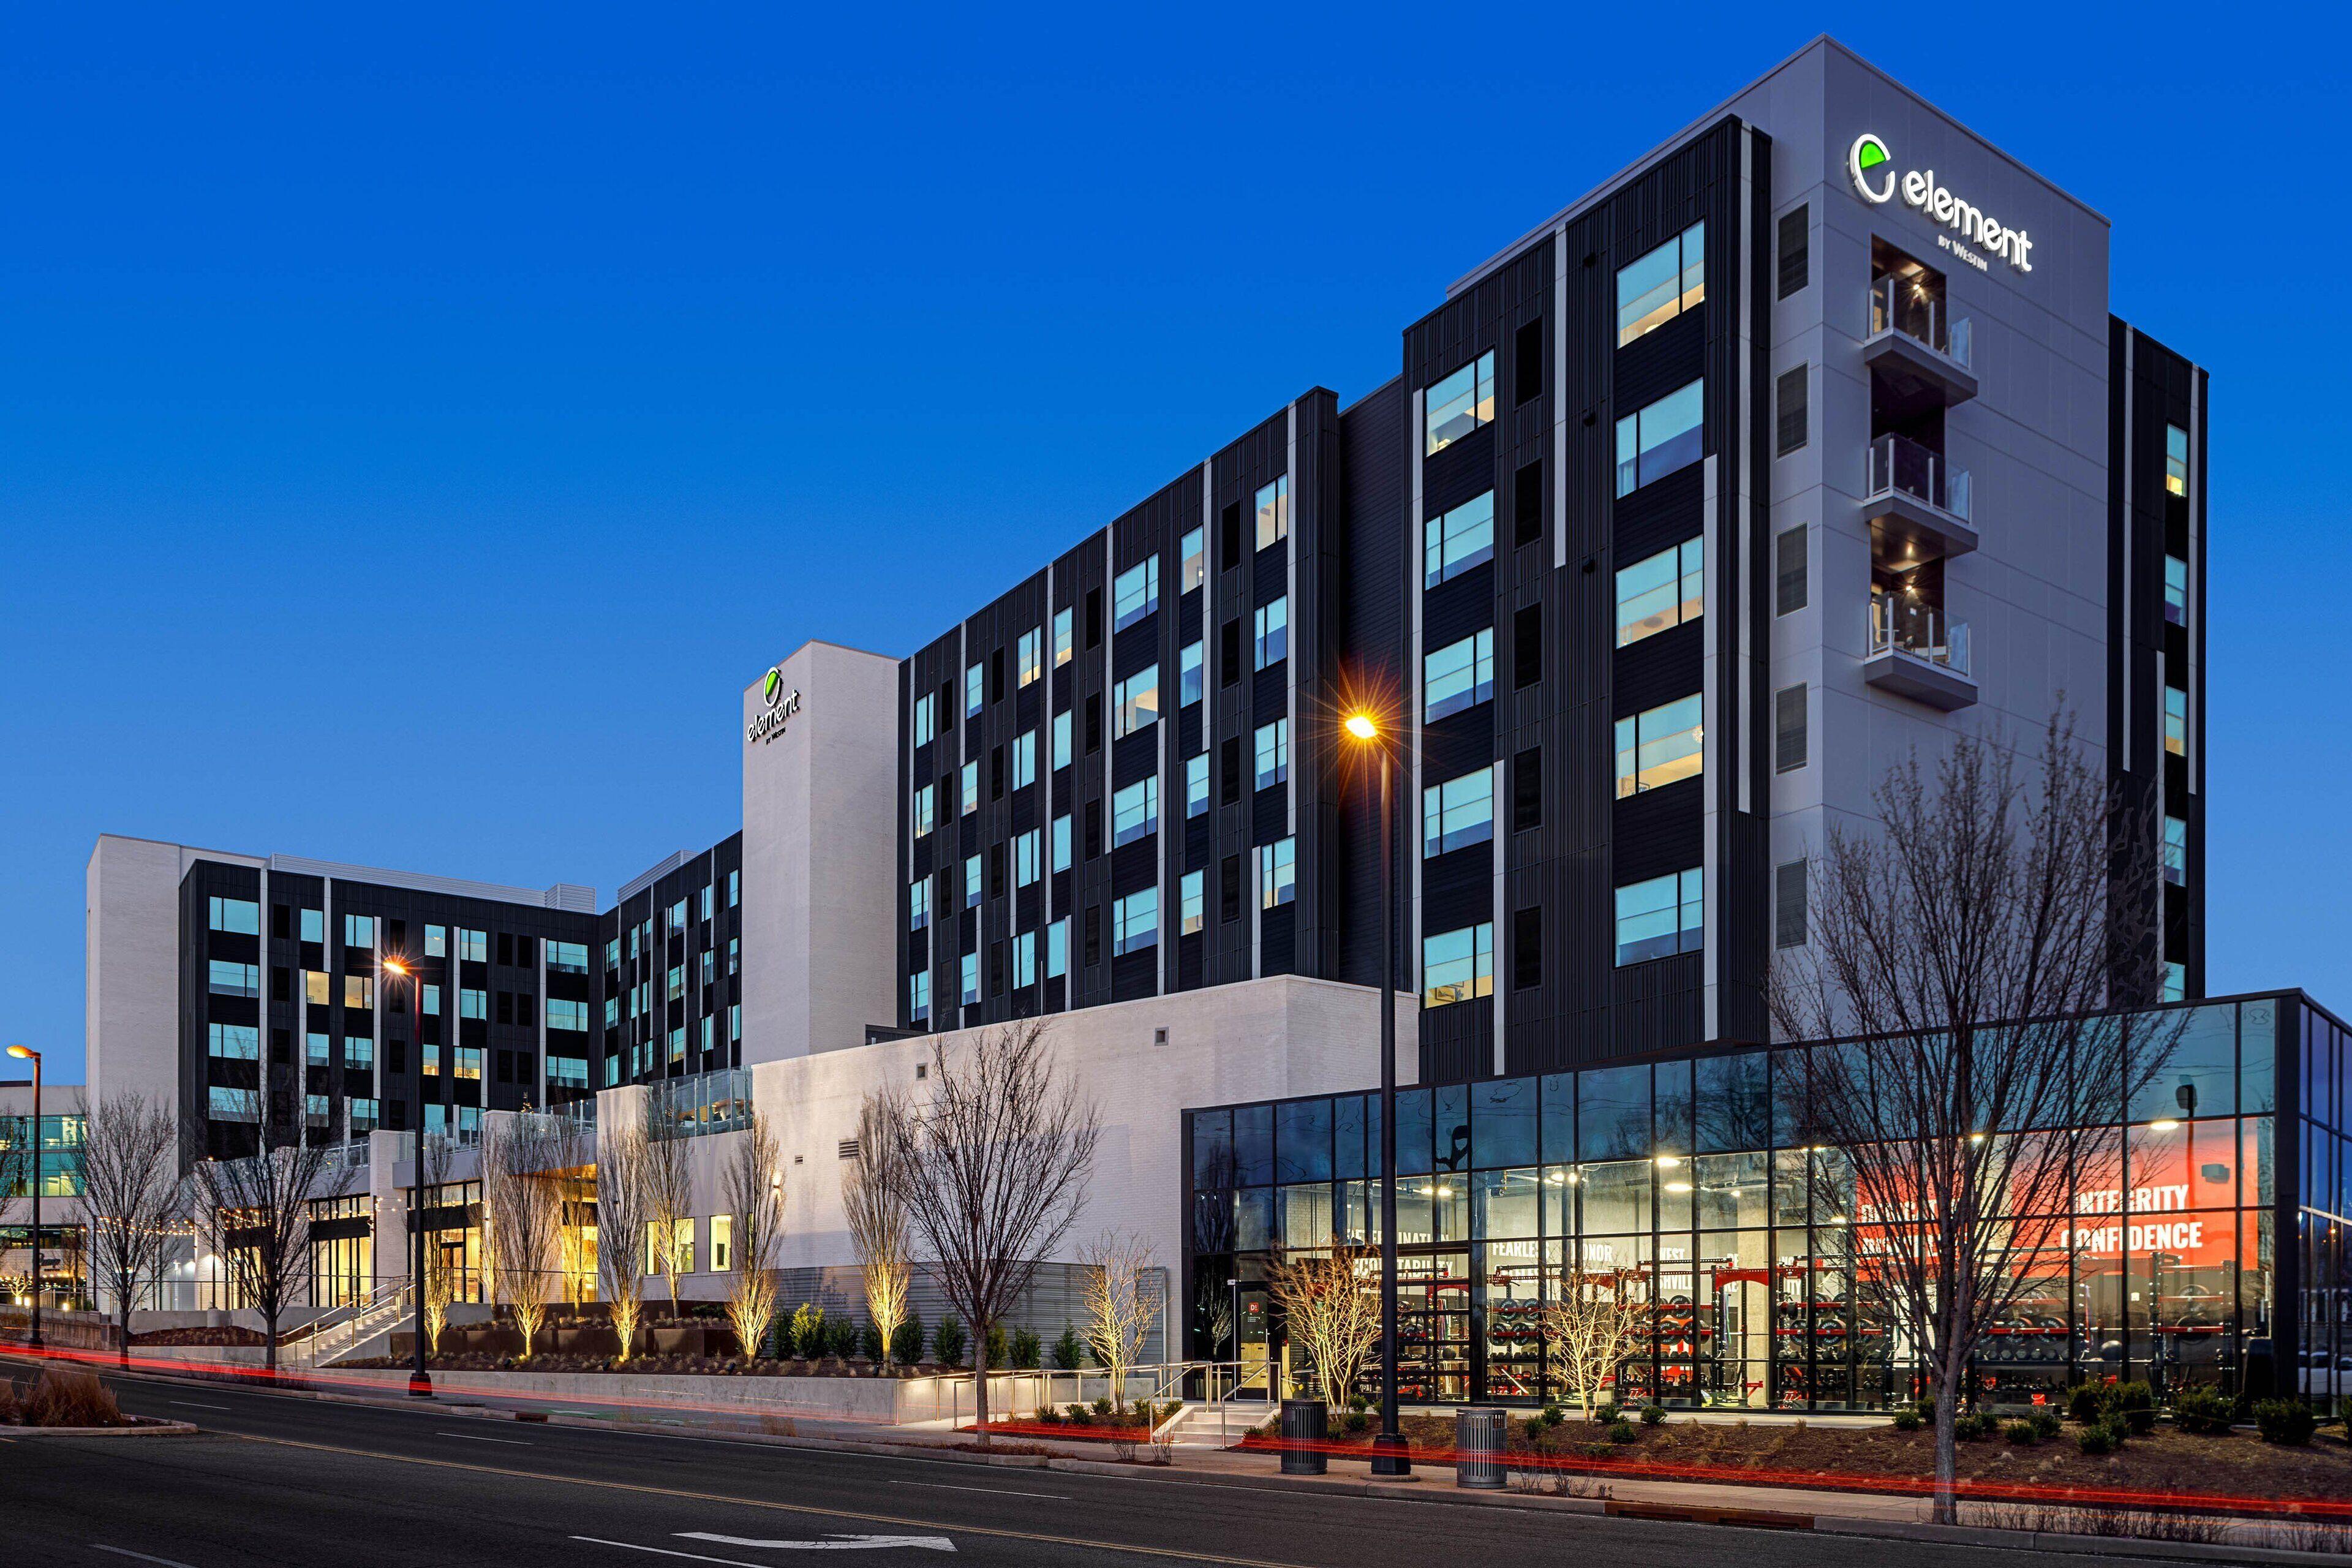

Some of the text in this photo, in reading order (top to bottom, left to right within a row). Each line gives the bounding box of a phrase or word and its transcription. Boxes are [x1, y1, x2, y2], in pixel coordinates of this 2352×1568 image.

[1902, 169, 2032, 271] element
[1938, 235, 1951, 250] BY
[747, 689, 799, 742] element
[1492, 1242, 1550, 1260] FEARLES
